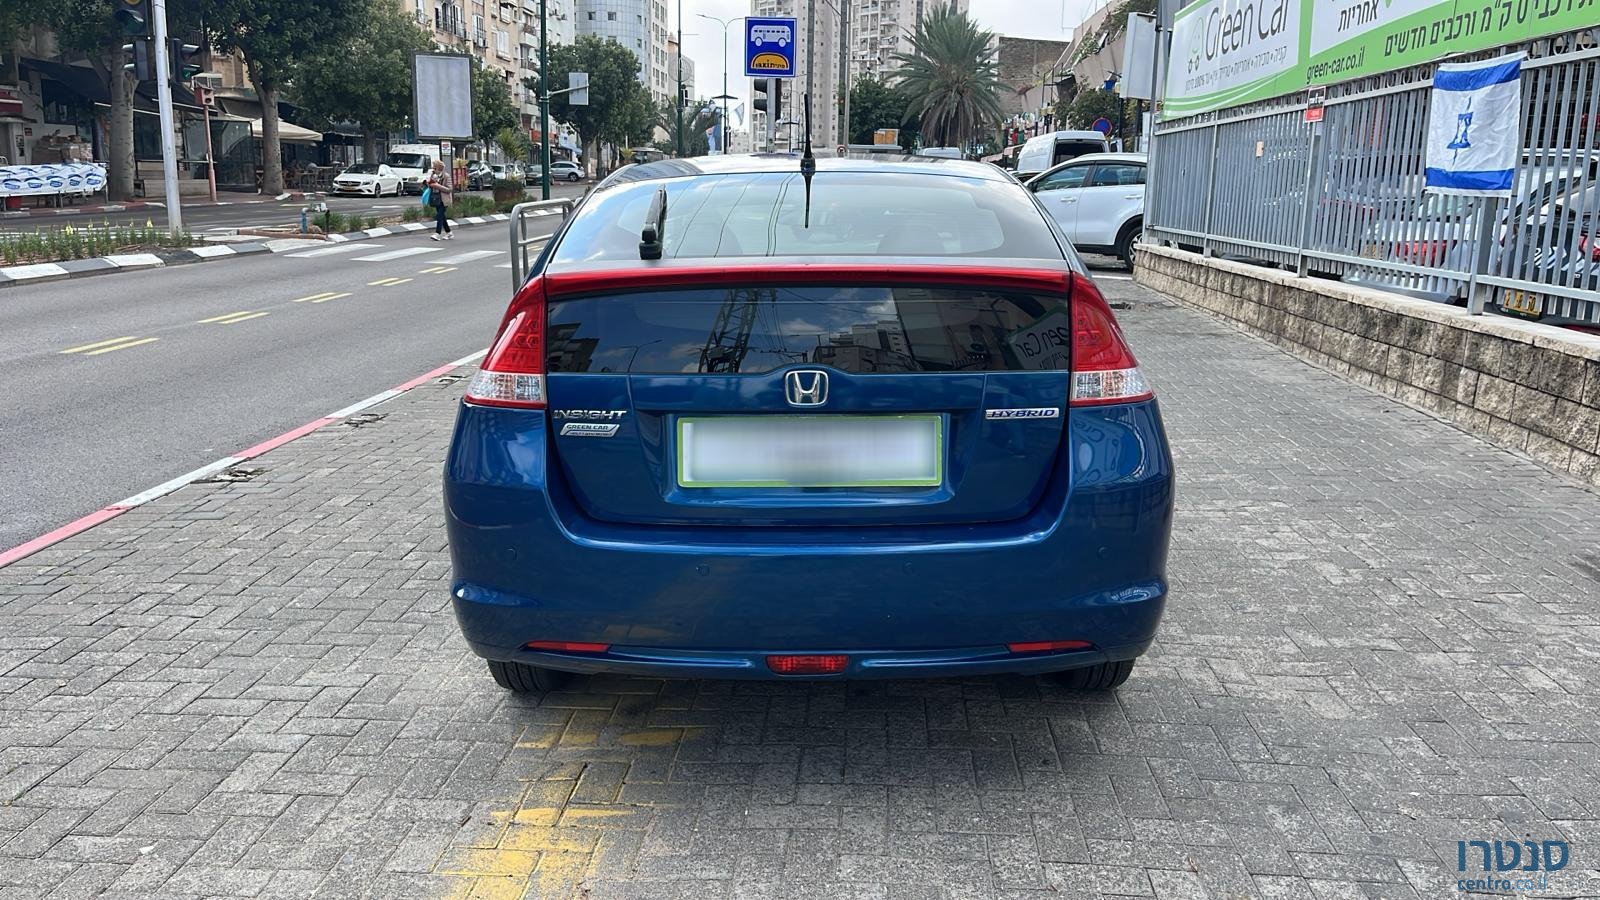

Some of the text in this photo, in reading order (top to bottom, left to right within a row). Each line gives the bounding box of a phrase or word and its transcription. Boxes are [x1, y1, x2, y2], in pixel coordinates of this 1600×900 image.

[1206, 3, 1254, 61] Green
[1338, 0, 1379, 32] אחריות
[1430, 11, 1477, 45] ורכבים
[1385, 26, 1427, 57] חדשים
[1306, 46, 1366, 85] green-car.co.il
[553, 409, 627, 420] INSIGHT
[991, 409, 1056, 418] HYBRID
